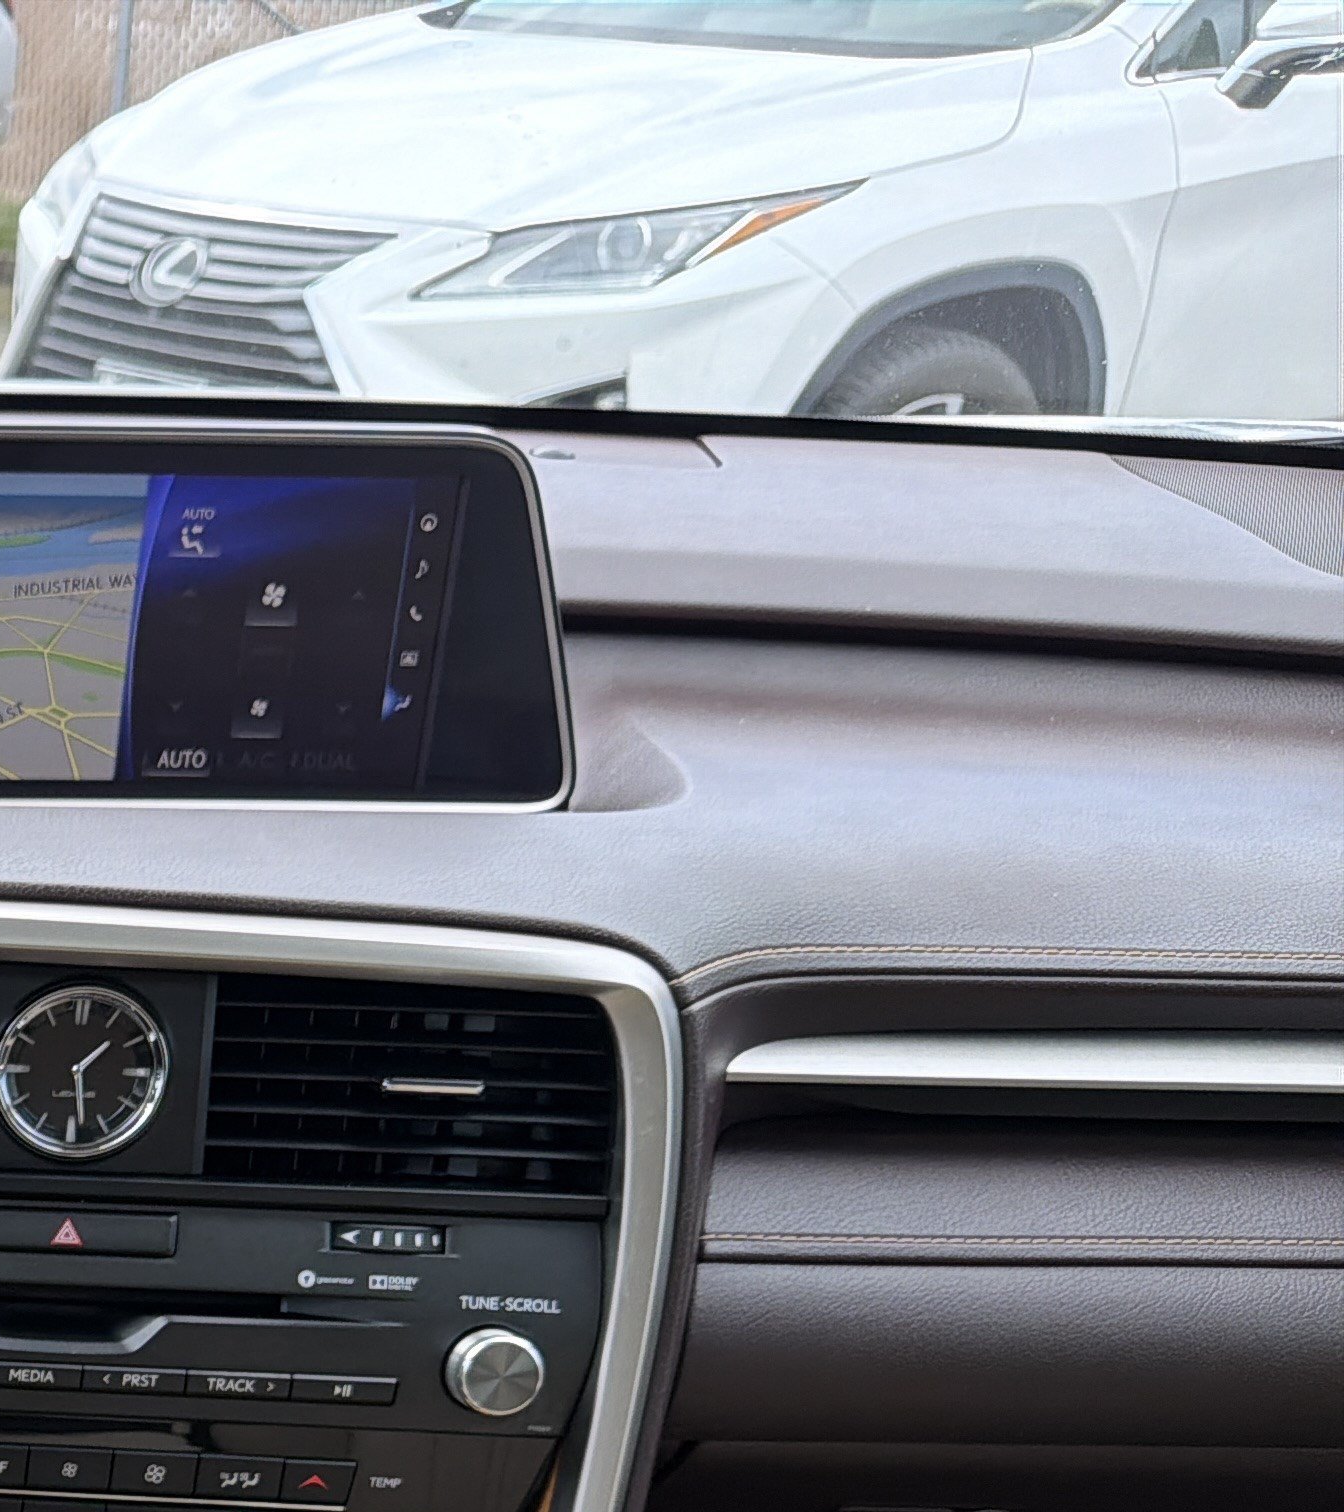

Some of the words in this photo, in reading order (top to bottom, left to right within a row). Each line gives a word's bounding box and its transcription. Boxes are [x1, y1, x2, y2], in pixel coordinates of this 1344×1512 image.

[181, 507, 216, 521] AUTO
[13, 576, 102, 598] INDUSTRIAL
[6, 701, 25, 724] ST
[156, 748, 208, 769] AUTO
[8, 1369, 54, 1384] MEDIA
[122, 1373, 159, 1389] PRST
[207, 1377, 255, 1394] TRACK
[369, 1476, 402, 1489] TEMP
